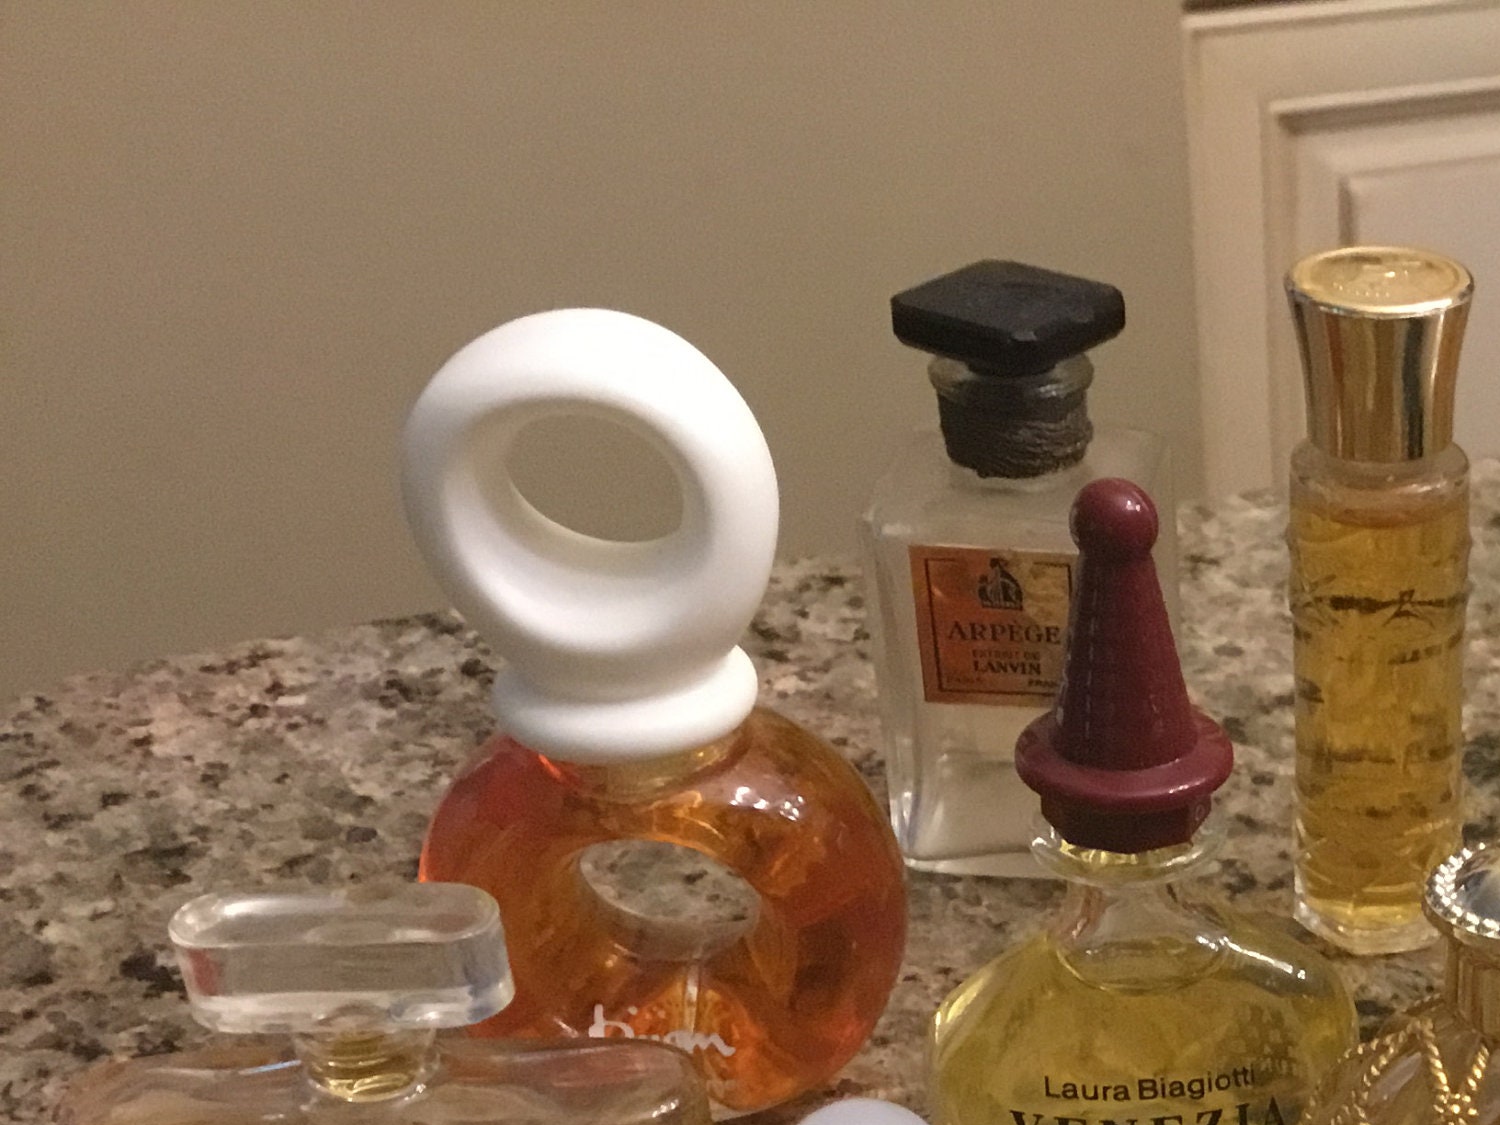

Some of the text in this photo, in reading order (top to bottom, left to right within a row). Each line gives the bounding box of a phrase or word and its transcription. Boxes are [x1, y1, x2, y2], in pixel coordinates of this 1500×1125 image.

[973, 660, 1042, 675] LANVIN
[1044, 1066, 1255, 1101] Laura Biagiotti
